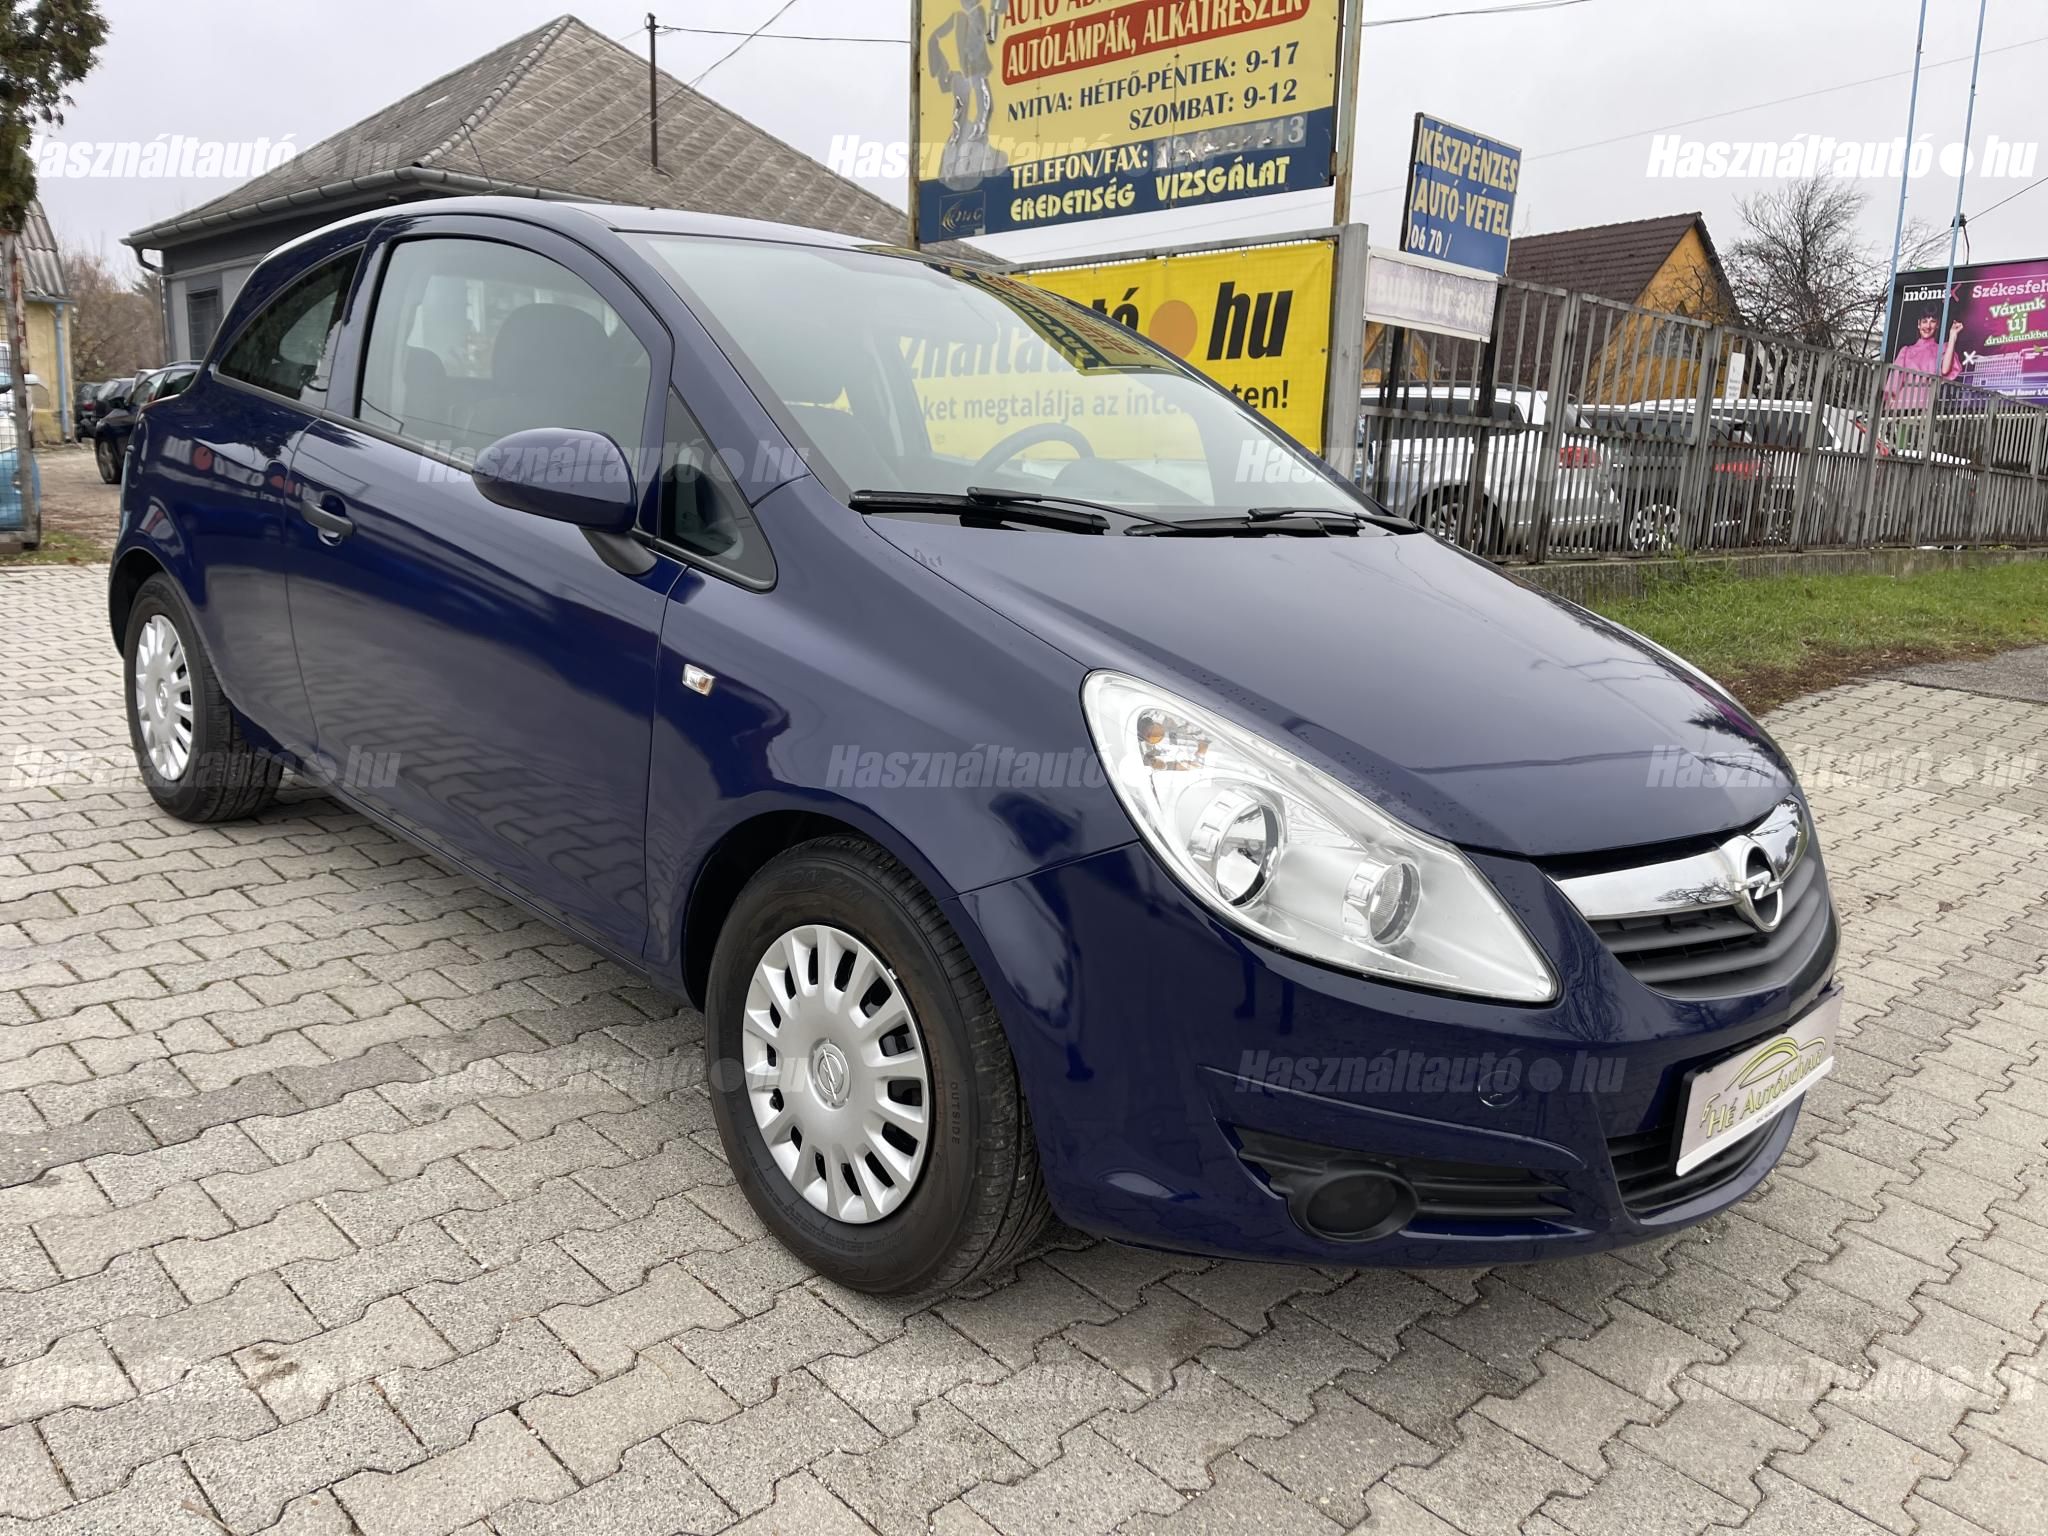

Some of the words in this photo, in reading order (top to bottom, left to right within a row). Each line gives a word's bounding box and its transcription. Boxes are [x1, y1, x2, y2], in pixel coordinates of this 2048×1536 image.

[1006, 10, 1137, 79] AUTÓLÁMPÁK,
[1007, 91, 1073, 123] NYITVA:
[1079, 55, 1237, 108] HÉTFŐ-PÉNTEK:
[1246, 41, 1300, 74] 9-17
[1128, 91, 1235, 131] SZOMBAT:
[1243, 78, 1298, 110] 9-12
[1010, 142, 1149, 190] TELEFON/FAX:
[1419, 125, 1519, 193] KÉSZPÉNZES
[1010, 177, 1136, 222] EREDETISÉG
[1155, 155, 1291, 201] VIZSGÁLAT
[1413, 180, 1511, 237] AUTÓ-VÉTEL
[1410, 228, 1427, 251] 06
[1428, 229, 1443, 256] 70
[1206, 281, 1294, 361] hu
[1989, 297, 2047, 318] Várunk
[2007, 313, 2029, 334] új
[963, 388, 1084, 424] megtalálja
[1092, 399, 1119, 416] az
[950, 1080, 961, 1146] OUTSIDE
